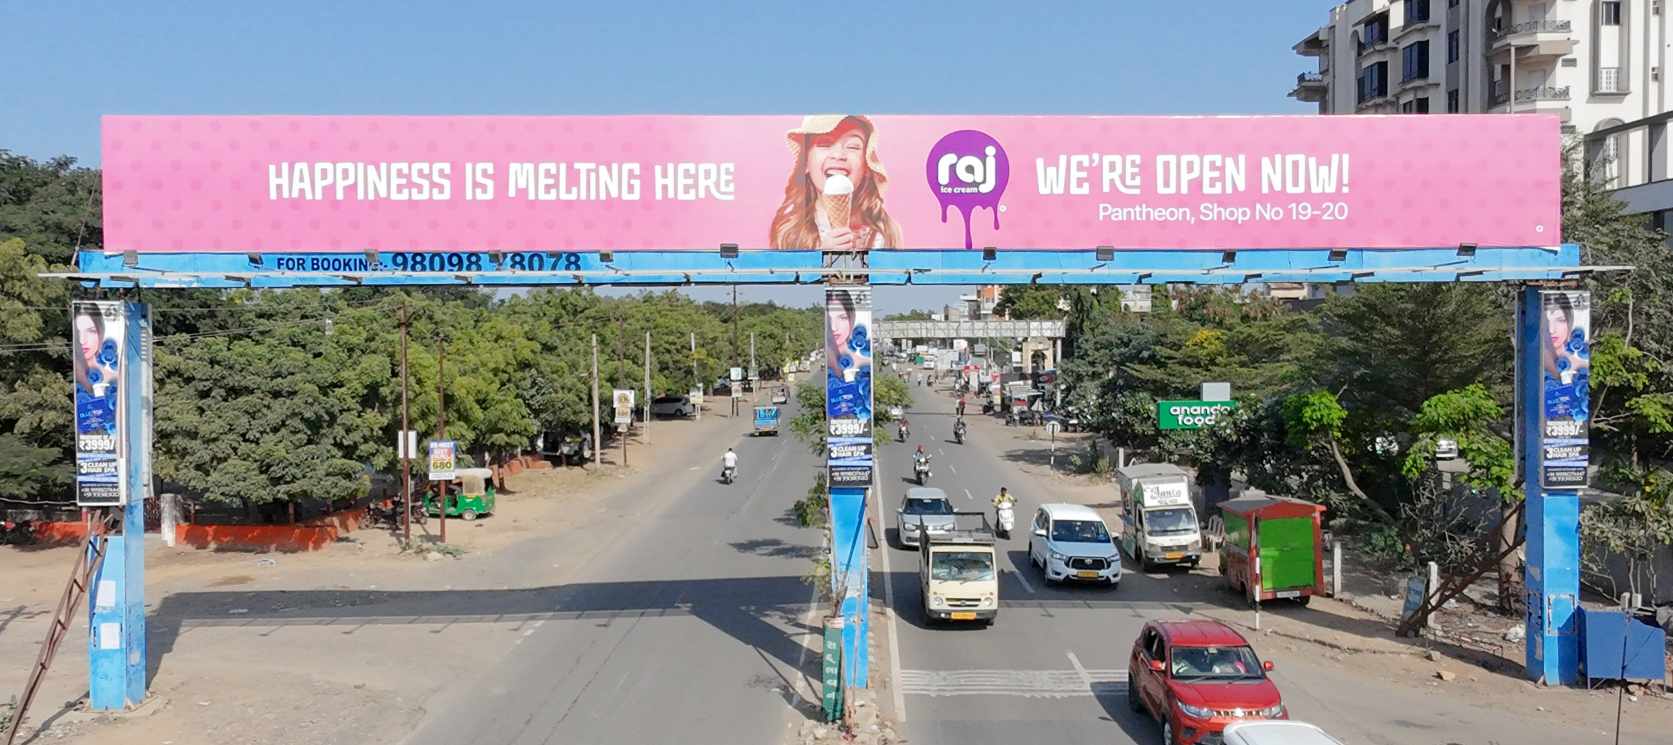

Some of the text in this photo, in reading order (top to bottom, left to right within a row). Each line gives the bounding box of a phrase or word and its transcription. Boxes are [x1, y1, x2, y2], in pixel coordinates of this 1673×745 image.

[268, 162, 736, 200] HAPPINESS IS MELTING HERE
[937, 145, 996, 193] raj
[1156, 153, 1246, 194] OPEN
[1261, 153, 1350, 194] NOW!
[1098, 203, 1196, 224] Pantheon,
[1199, 202, 1251, 224] Shop
[1256, 203, 1284, 221] No
[277, 257, 306, 271] FOR
[392, 252, 482, 272] 98098
